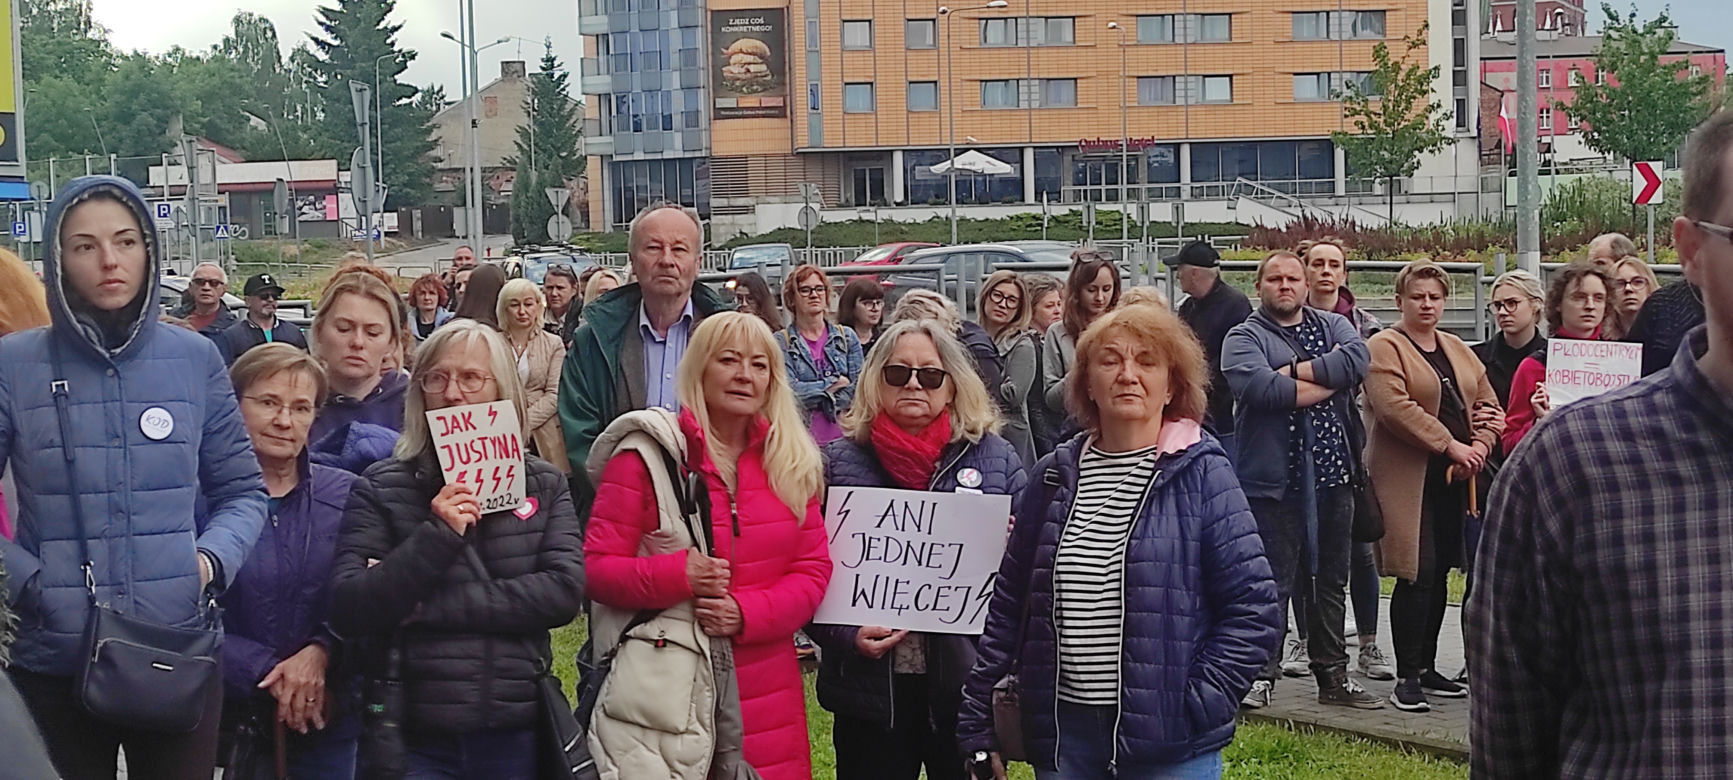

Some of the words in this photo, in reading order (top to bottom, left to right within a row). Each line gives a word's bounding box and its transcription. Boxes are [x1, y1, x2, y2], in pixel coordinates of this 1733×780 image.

[159, 206, 170, 217] P
[15, 223, 25, 234] P
[261, 275, 270, 284] T
[436, 411, 477, 437] JAK
[440, 433, 521, 472] JUSTYNA
[875, 499, 938, 536] ANI
[841, 532, 964, 580] JEDNEJ
[851, 573, 973, 624] WIĘCEJ
